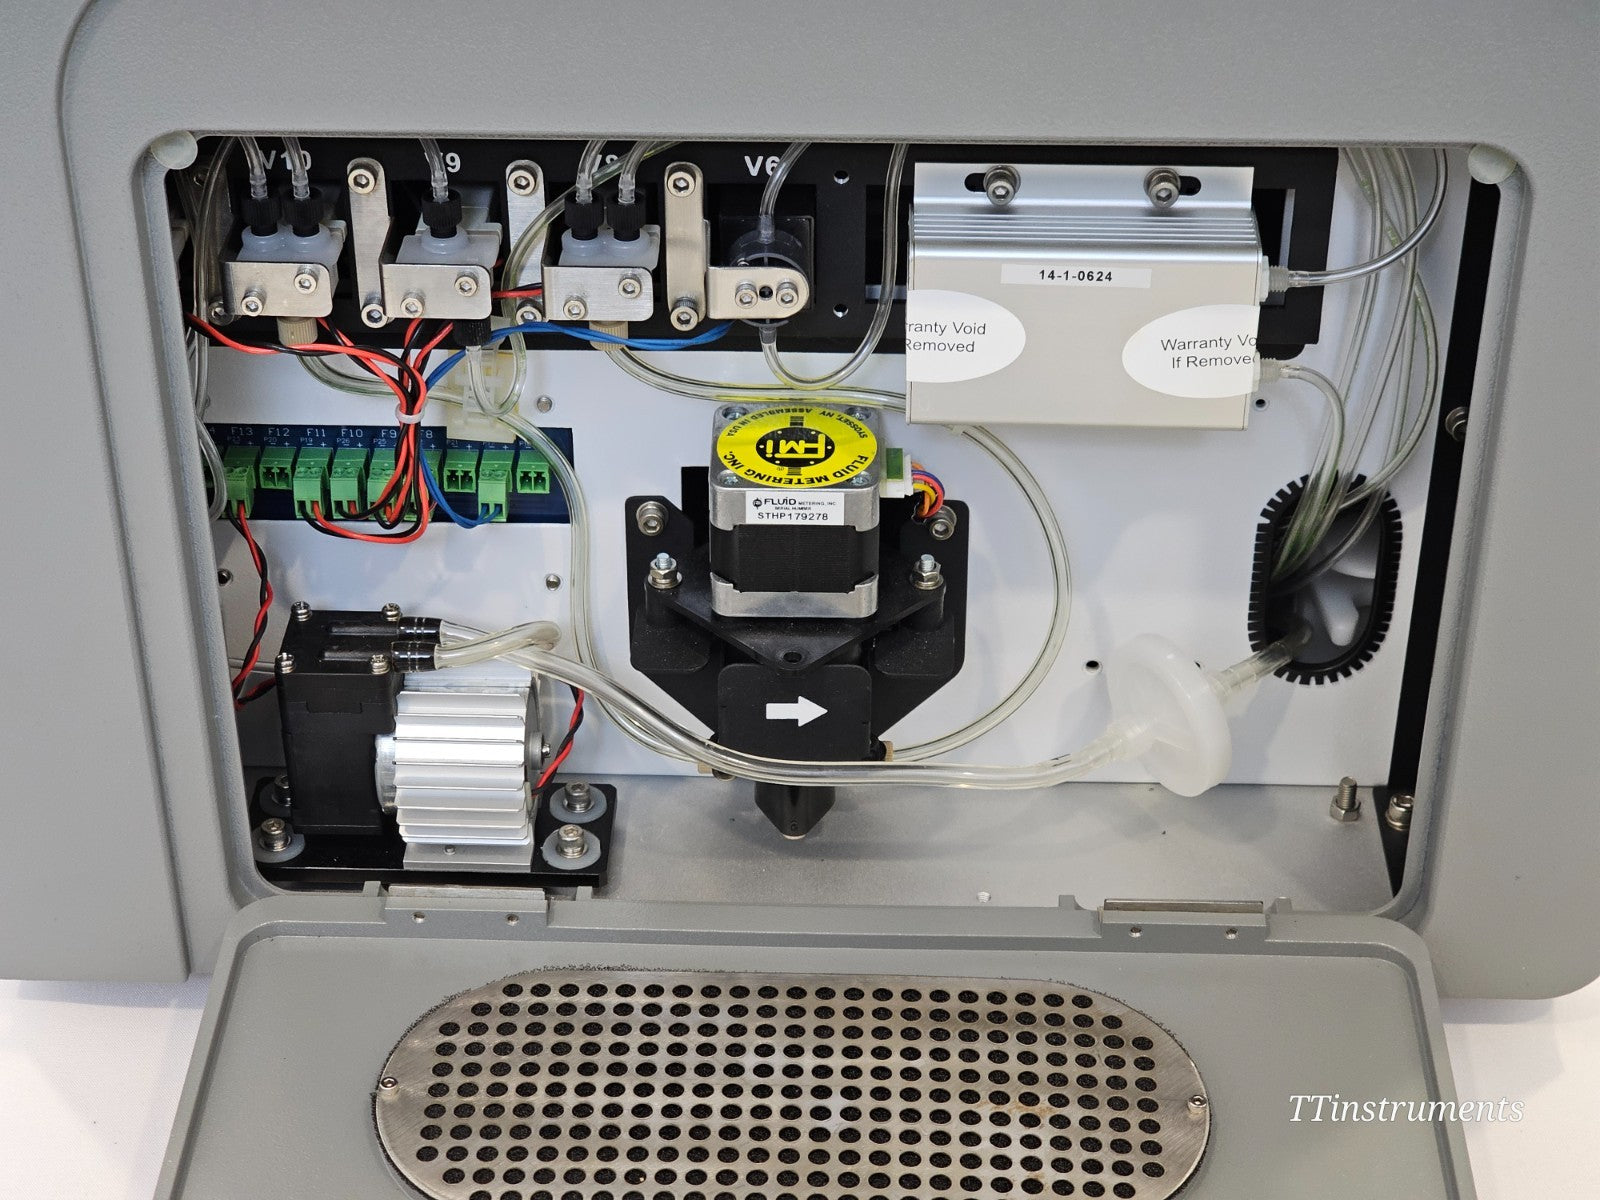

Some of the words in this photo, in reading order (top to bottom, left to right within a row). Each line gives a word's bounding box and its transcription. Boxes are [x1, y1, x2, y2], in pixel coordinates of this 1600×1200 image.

[744, 155, 780, 177] V6
[1039, 269, 1113, 282] 14-1-0624
[905, 321, 947, 337] ranty
[952, 320, 987, 336] Void
[1161, 335, 1232, 351] Warranty
[1171, 356, 1181, 368] If
[819, 410, 835, 418] NY
[739, 418, 750, 426] IN
[231, 426, 254, 437] F13
[268, 427, 291, 437] F12
[306, 428, 326, 437] F11
[341, 428, 364, 438] F10
[381, 429, 398, 438] F9
[727, 425, 742, 437] USA
[723, 450, 743, 467] INC.
[833, 454, 869, 478] FLUID
[744, 468, 830, 485] METERING
[757, 512, 829, 521] STHP179278
